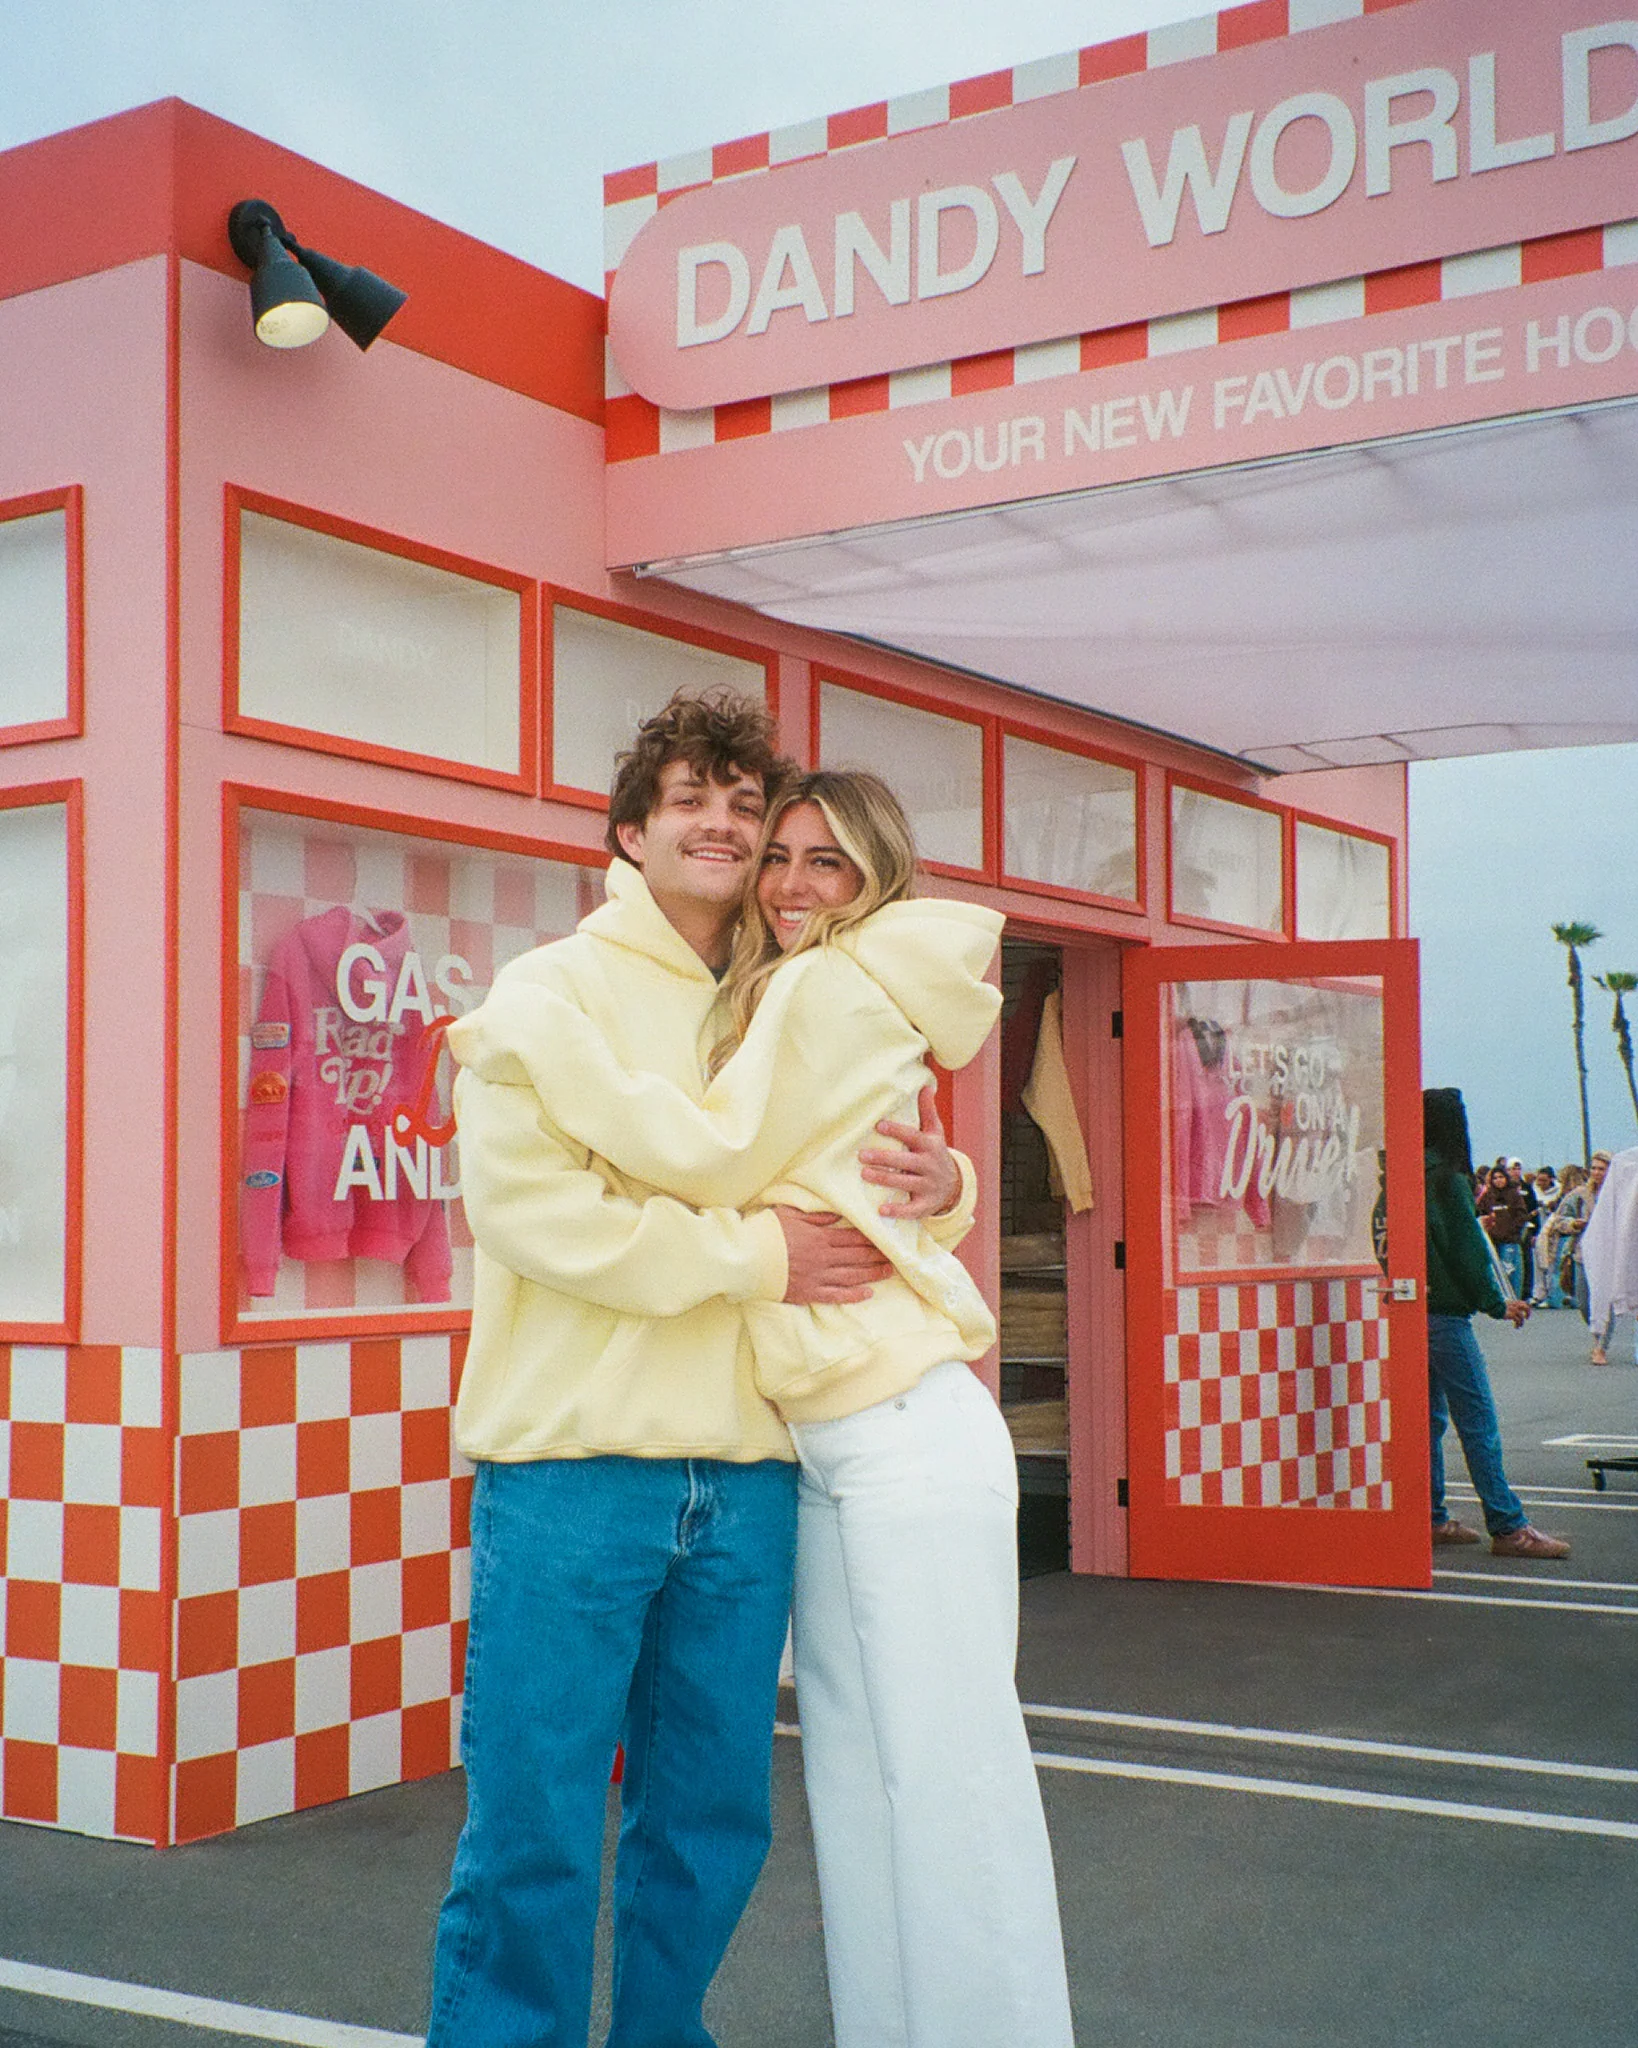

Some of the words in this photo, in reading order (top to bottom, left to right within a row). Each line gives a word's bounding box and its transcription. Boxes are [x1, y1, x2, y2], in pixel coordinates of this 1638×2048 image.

[675, 155, 1078, 349] DANDY
[1120, 19, 1638, 248] WORLD
[903, 414, 1047, 484] YOUR
[1062, 384, 1195, 457] NEW
[1212, 325, 1505, 430] FAVORITE
[1525, 305, 1638, 374] HO
[336, 942, 473, 1026] GAS
[1229, 1042, 1289, 1084] LET'S
[1295, 1046, 1325, 1089] GO
[1296, 1091, 1326, 1131] ON
